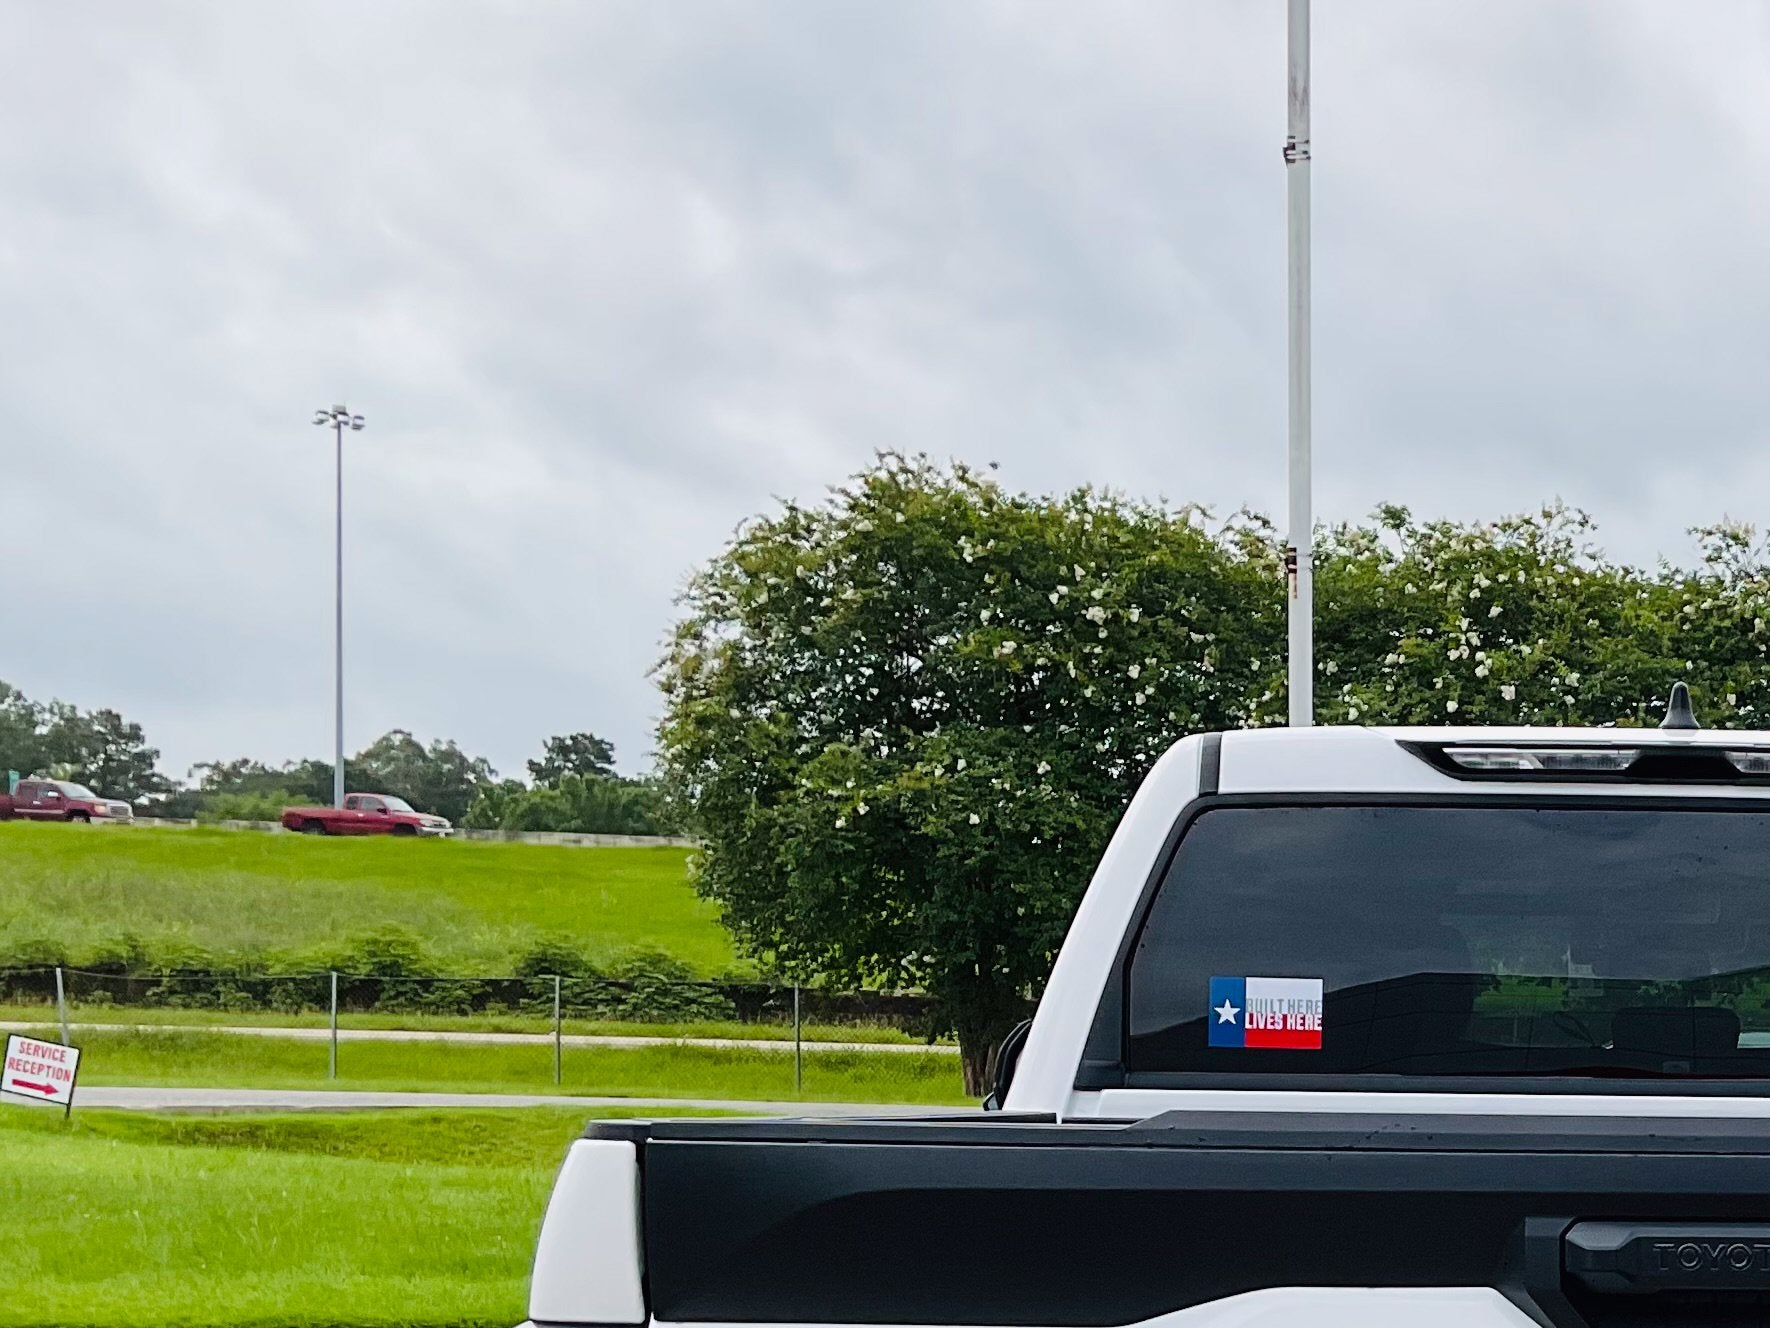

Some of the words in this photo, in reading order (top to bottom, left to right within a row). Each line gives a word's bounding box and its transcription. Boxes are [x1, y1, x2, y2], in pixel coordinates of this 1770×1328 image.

[1246, 999, 1286, 1014] BUILT
[1287, 999, 1322, 1015] HERE
[1245, 1013, 1283, 1030] LIVES
[1287, 1013, 1322, 1031] HERE
[19, 1040, 67, 1063] SERVICE
[8, 1056, 72, 1082] RECEPTION
